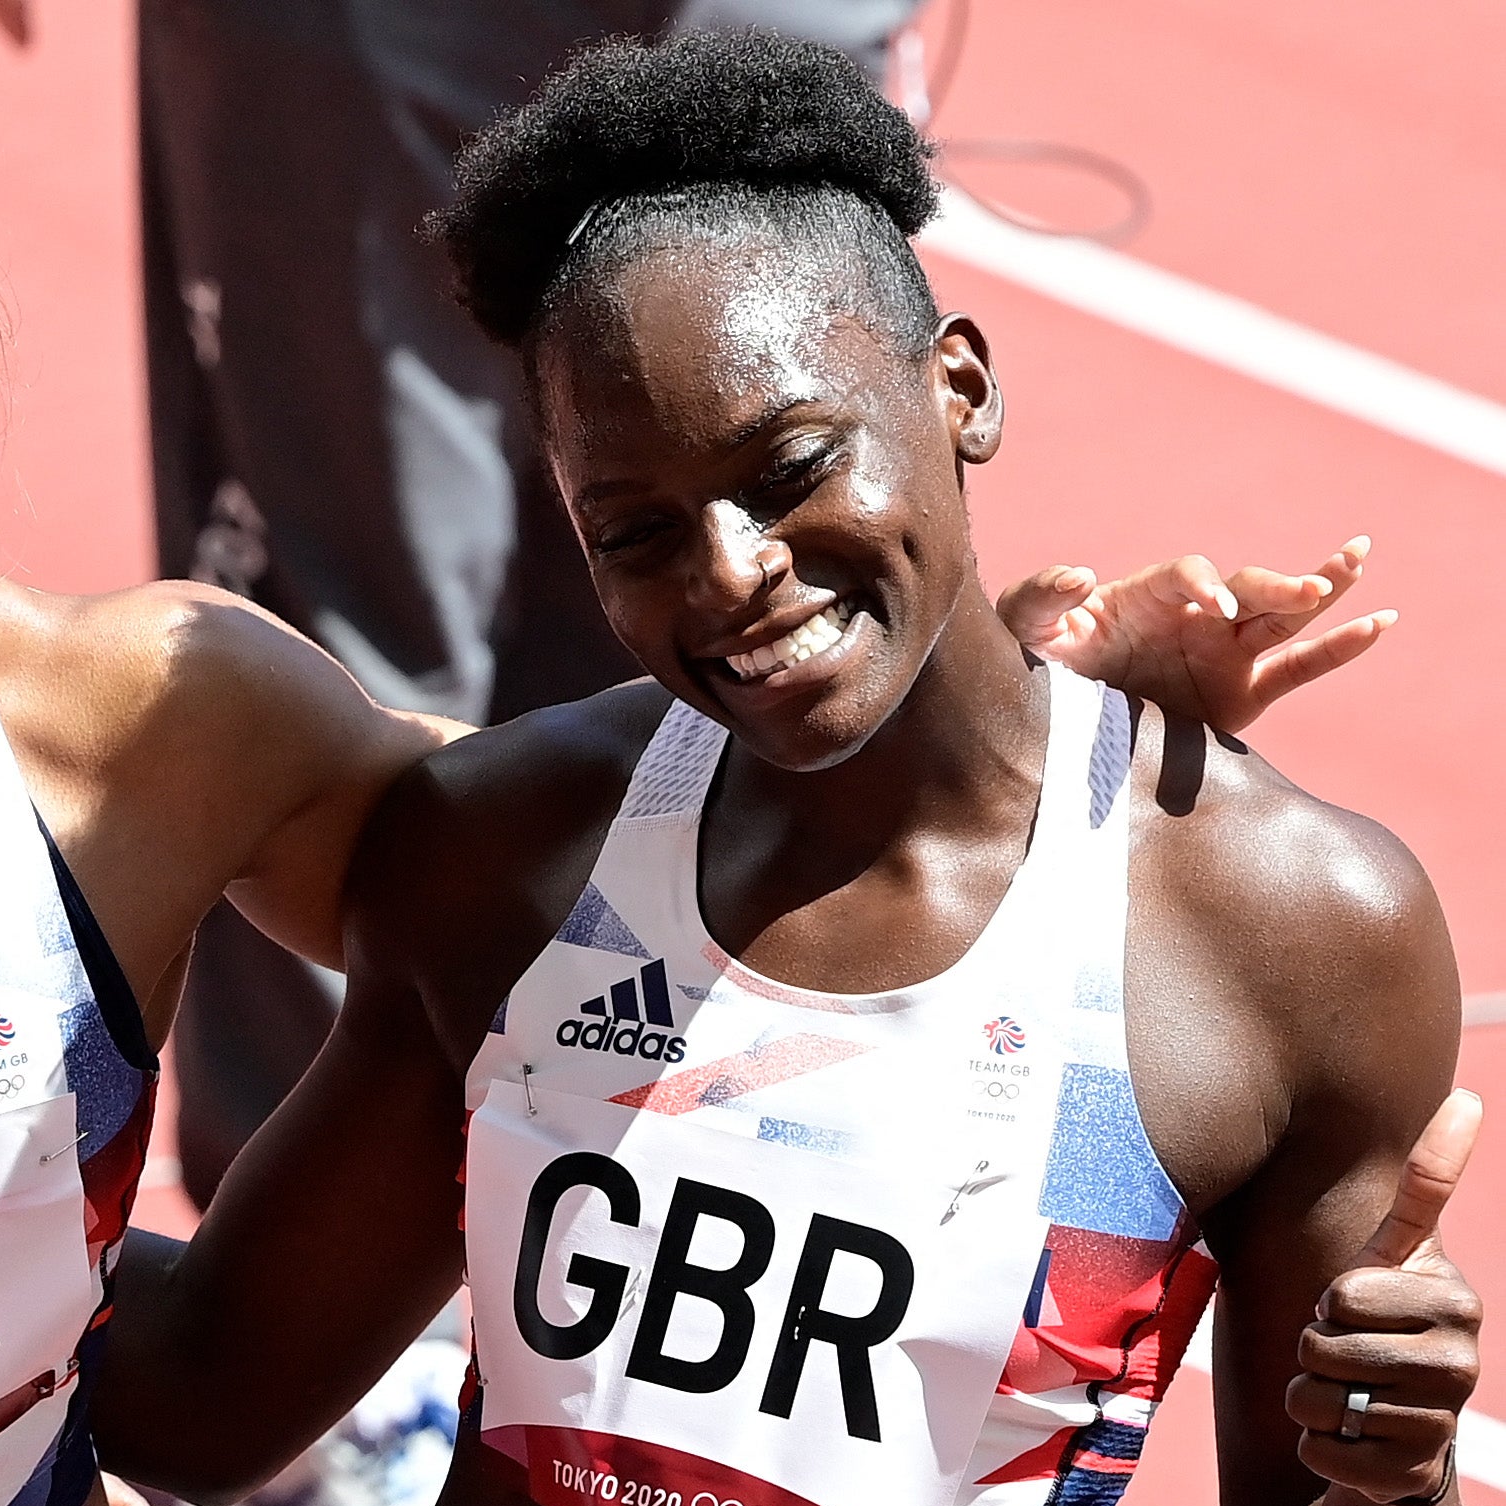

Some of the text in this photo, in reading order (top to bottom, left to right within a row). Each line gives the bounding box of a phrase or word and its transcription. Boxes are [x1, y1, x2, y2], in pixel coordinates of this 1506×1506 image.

[10, 1052, 29, 1067] GB
[555, 1015, 686, 1064] adidas
[968, 1059, 1030, 1077] TEAM GB
[513, 1151, 915, 1443] GBR
[552, 1458, 619, 1501] TOKYO
